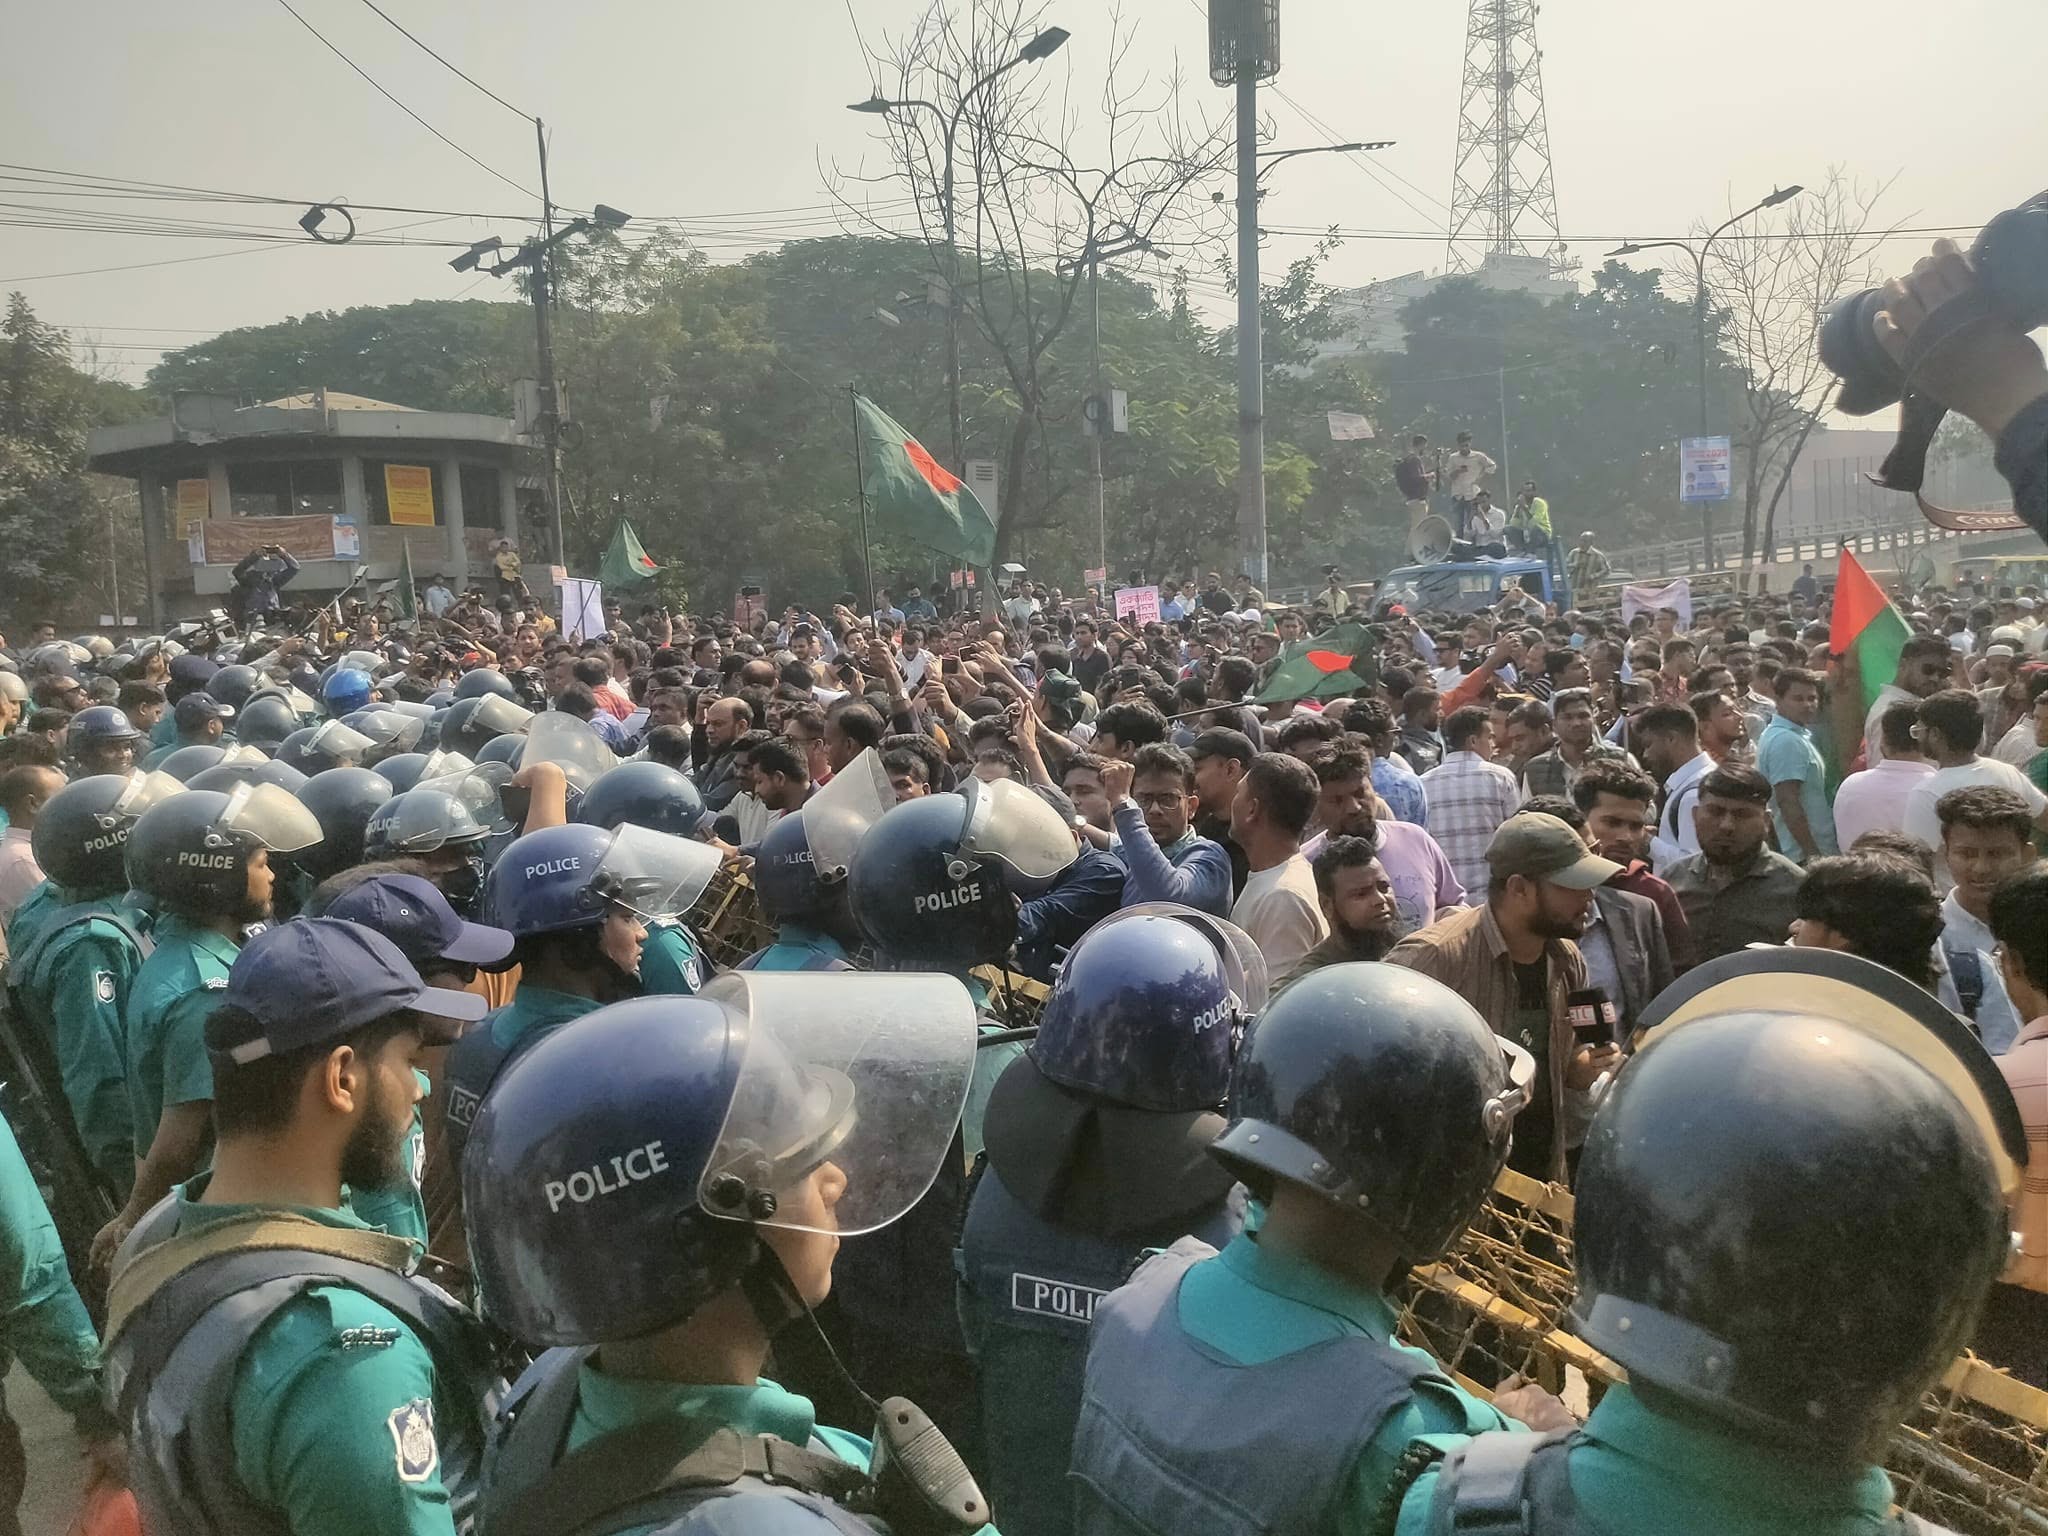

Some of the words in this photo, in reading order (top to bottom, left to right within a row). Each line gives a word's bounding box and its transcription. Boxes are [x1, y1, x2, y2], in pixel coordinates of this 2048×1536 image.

[84, 827, 131, 853] POLIC
[179, 851, 234, 870] POLICE
[525, 857, 580, 879] POLICE
[914, 882, 982, 914] POLICE
[545, 1140, 669, 1213] POLICE
[1034, 1282, 1105, 1320] POLI
